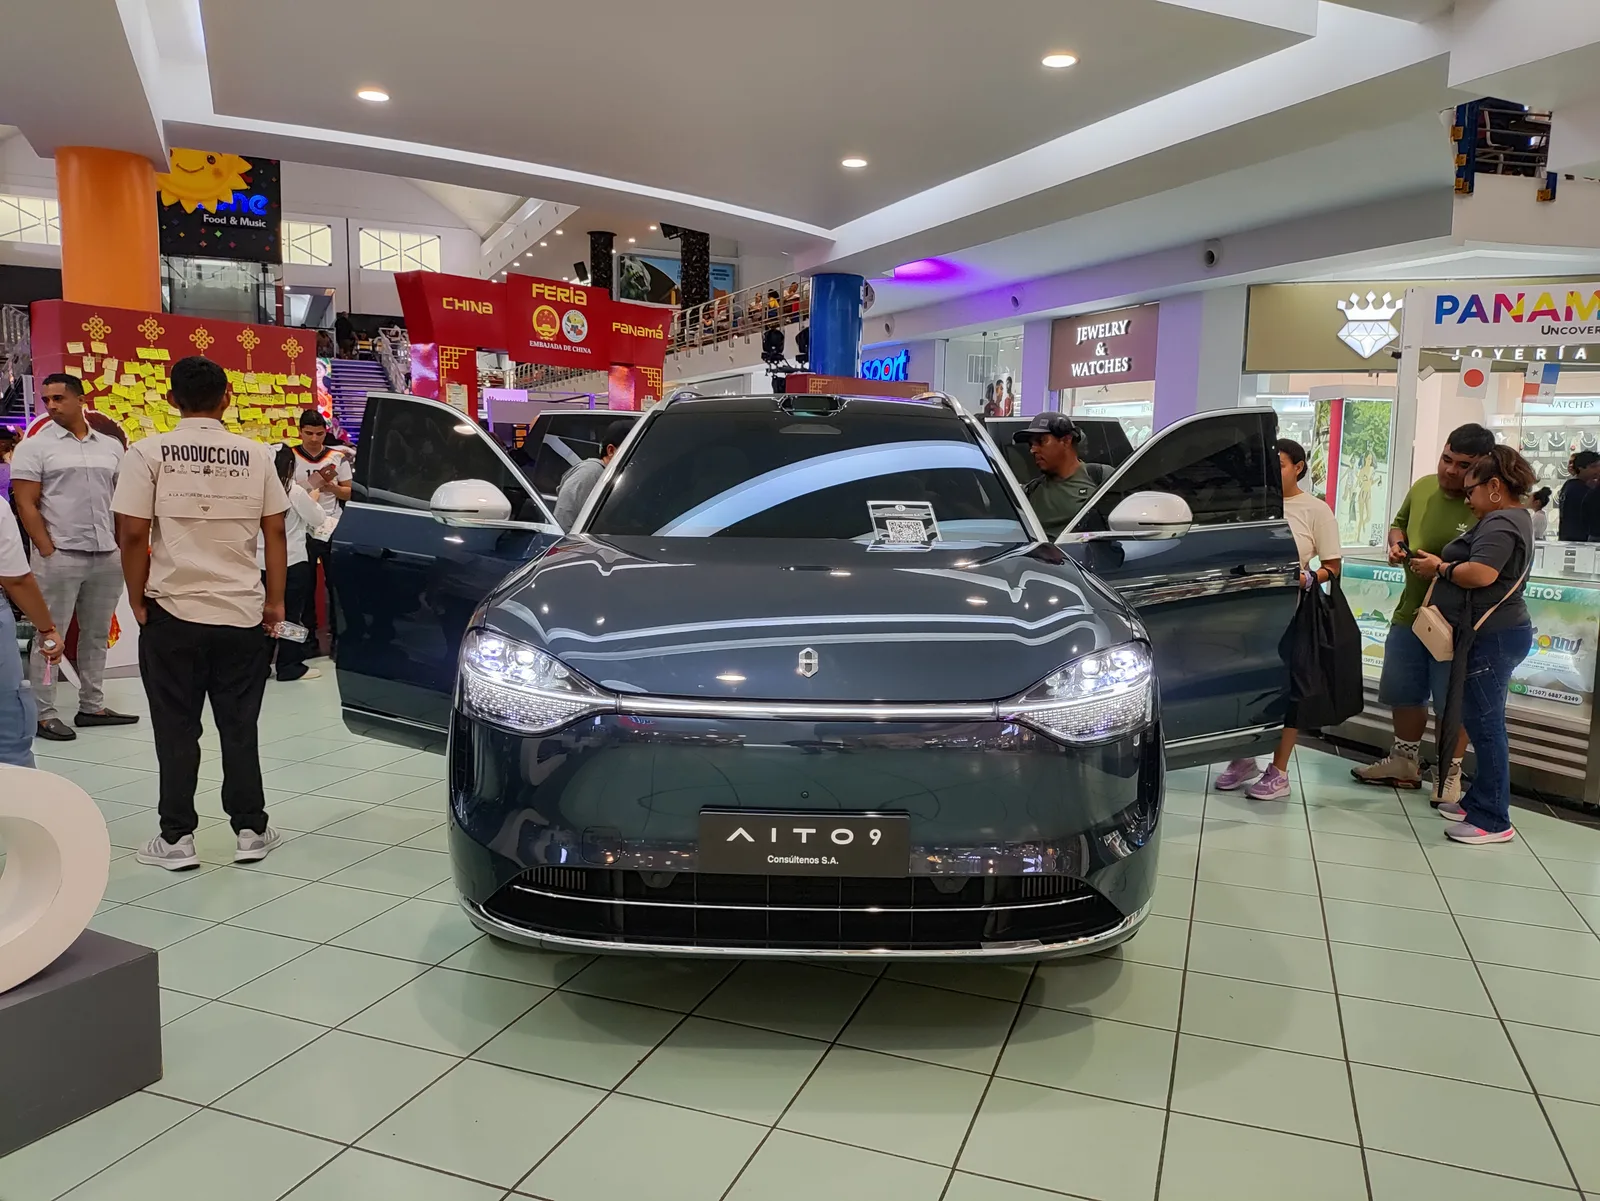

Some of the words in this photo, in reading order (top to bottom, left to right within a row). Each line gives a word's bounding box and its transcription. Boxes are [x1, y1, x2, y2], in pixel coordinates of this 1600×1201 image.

[203, 214, 227, 225] Food
[229, 216, 238, 226] &
[240, 217, 267, 228] Music
[1076, 319, 1130, 346] JEWELRY
[529, 340, 563, 351] EMBAJADA
[563, 345, 572, 353] DE
[572, 346, 592, 355] CHINA
[1095, 341, 1107, 357] &
[1071, 356, 1130, 378] WATCHES
[161, 445, 250, 467] PRODUCCIÓN
[869, 828, 882, 846] 9
[767, 854, 819, 865] Consúltenos
[821, 856, 839, 865] S.A.
